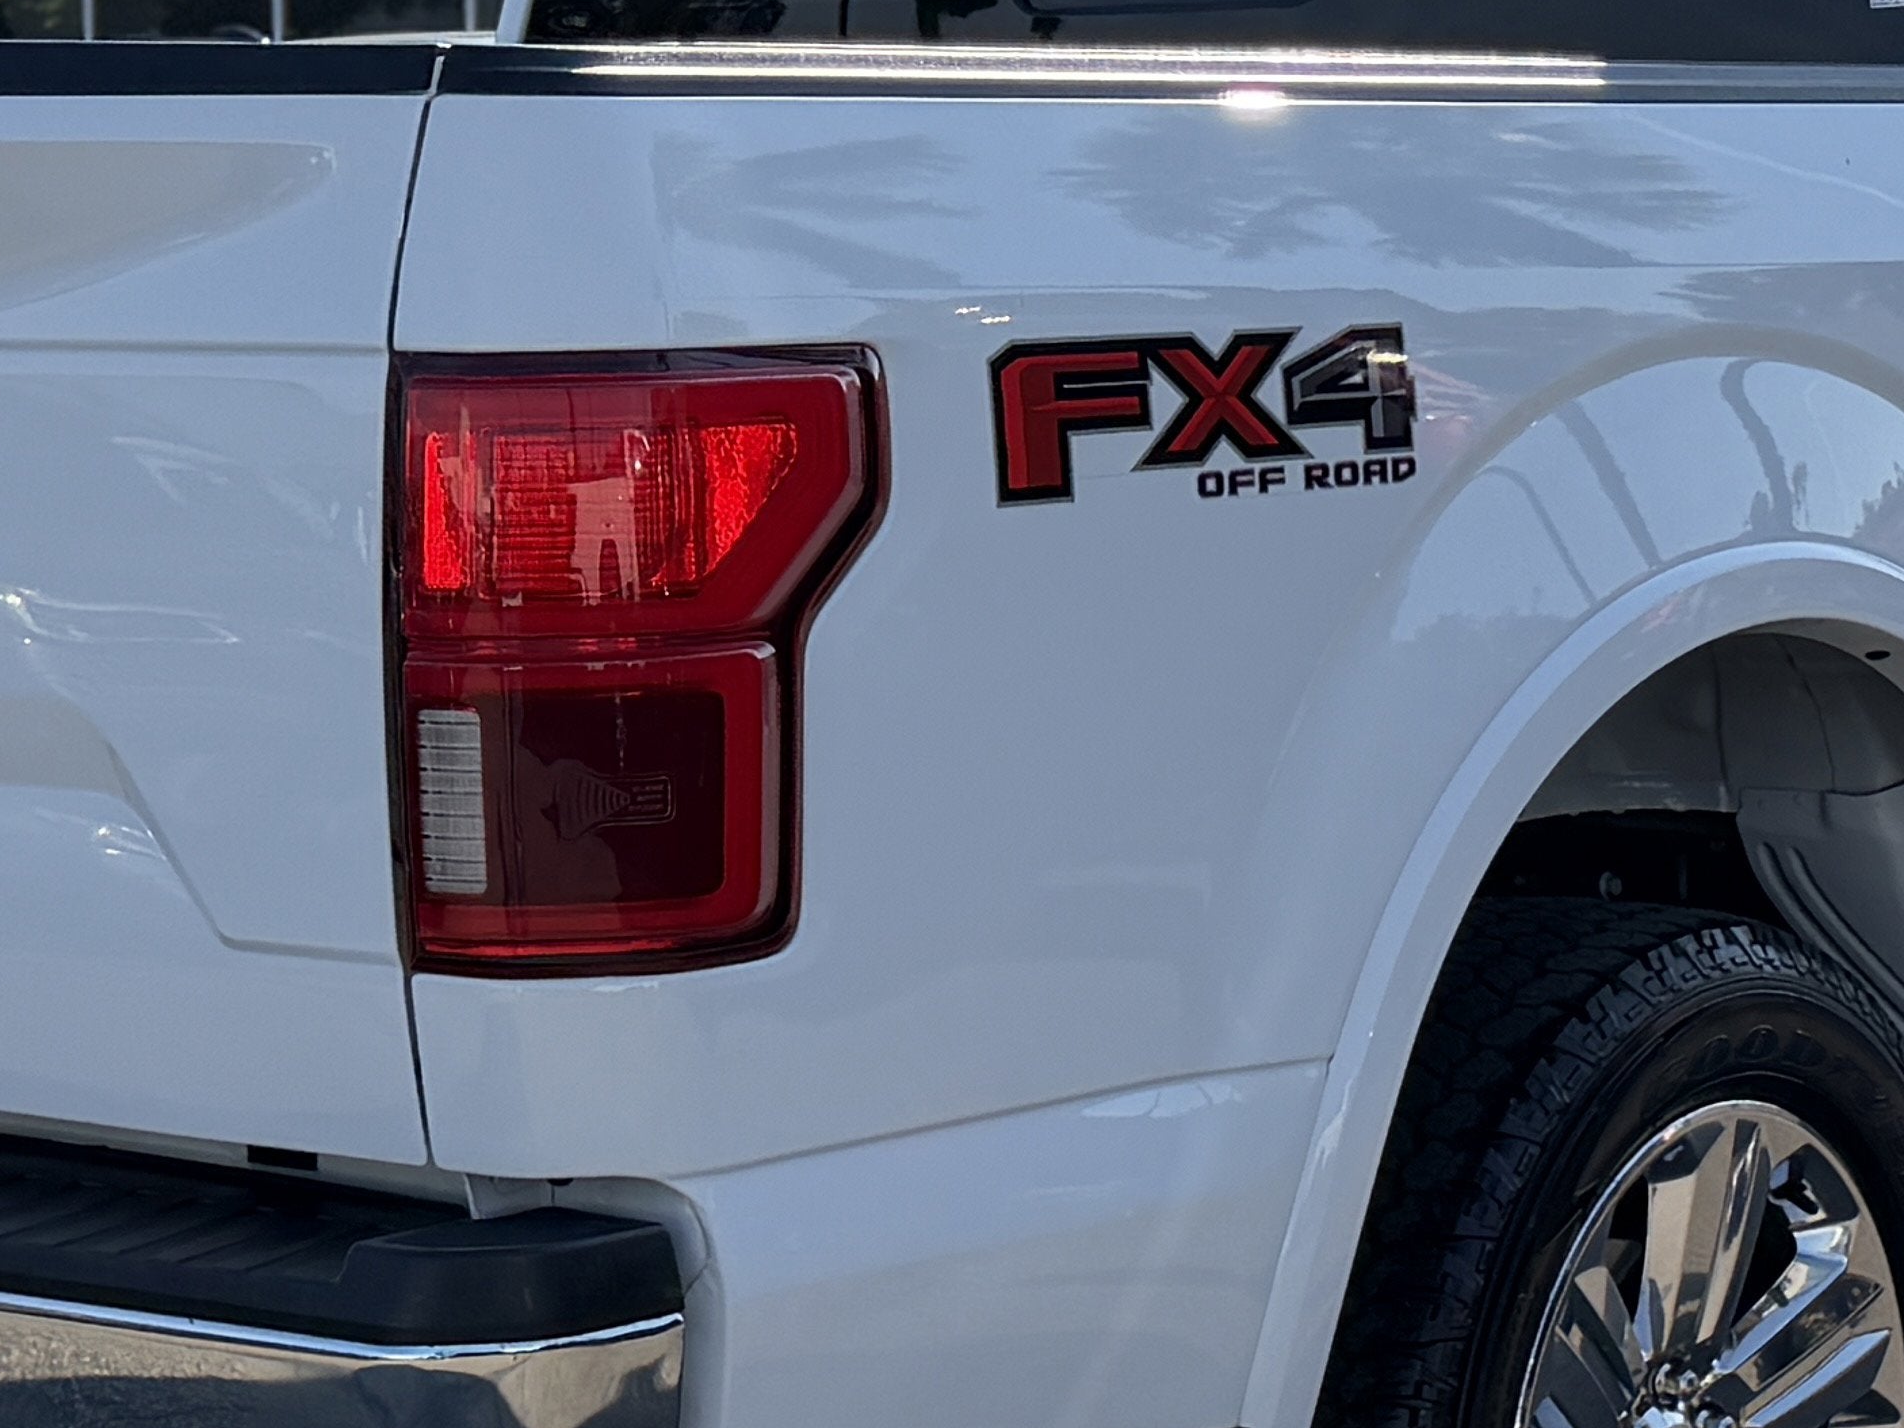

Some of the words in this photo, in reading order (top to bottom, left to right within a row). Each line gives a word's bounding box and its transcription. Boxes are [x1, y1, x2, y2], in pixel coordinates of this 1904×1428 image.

[987, 322, 1418, 509] FX4
[1197, 465, 1286, 499] OFF
[1304, 456, 1417, 492] ROAD
